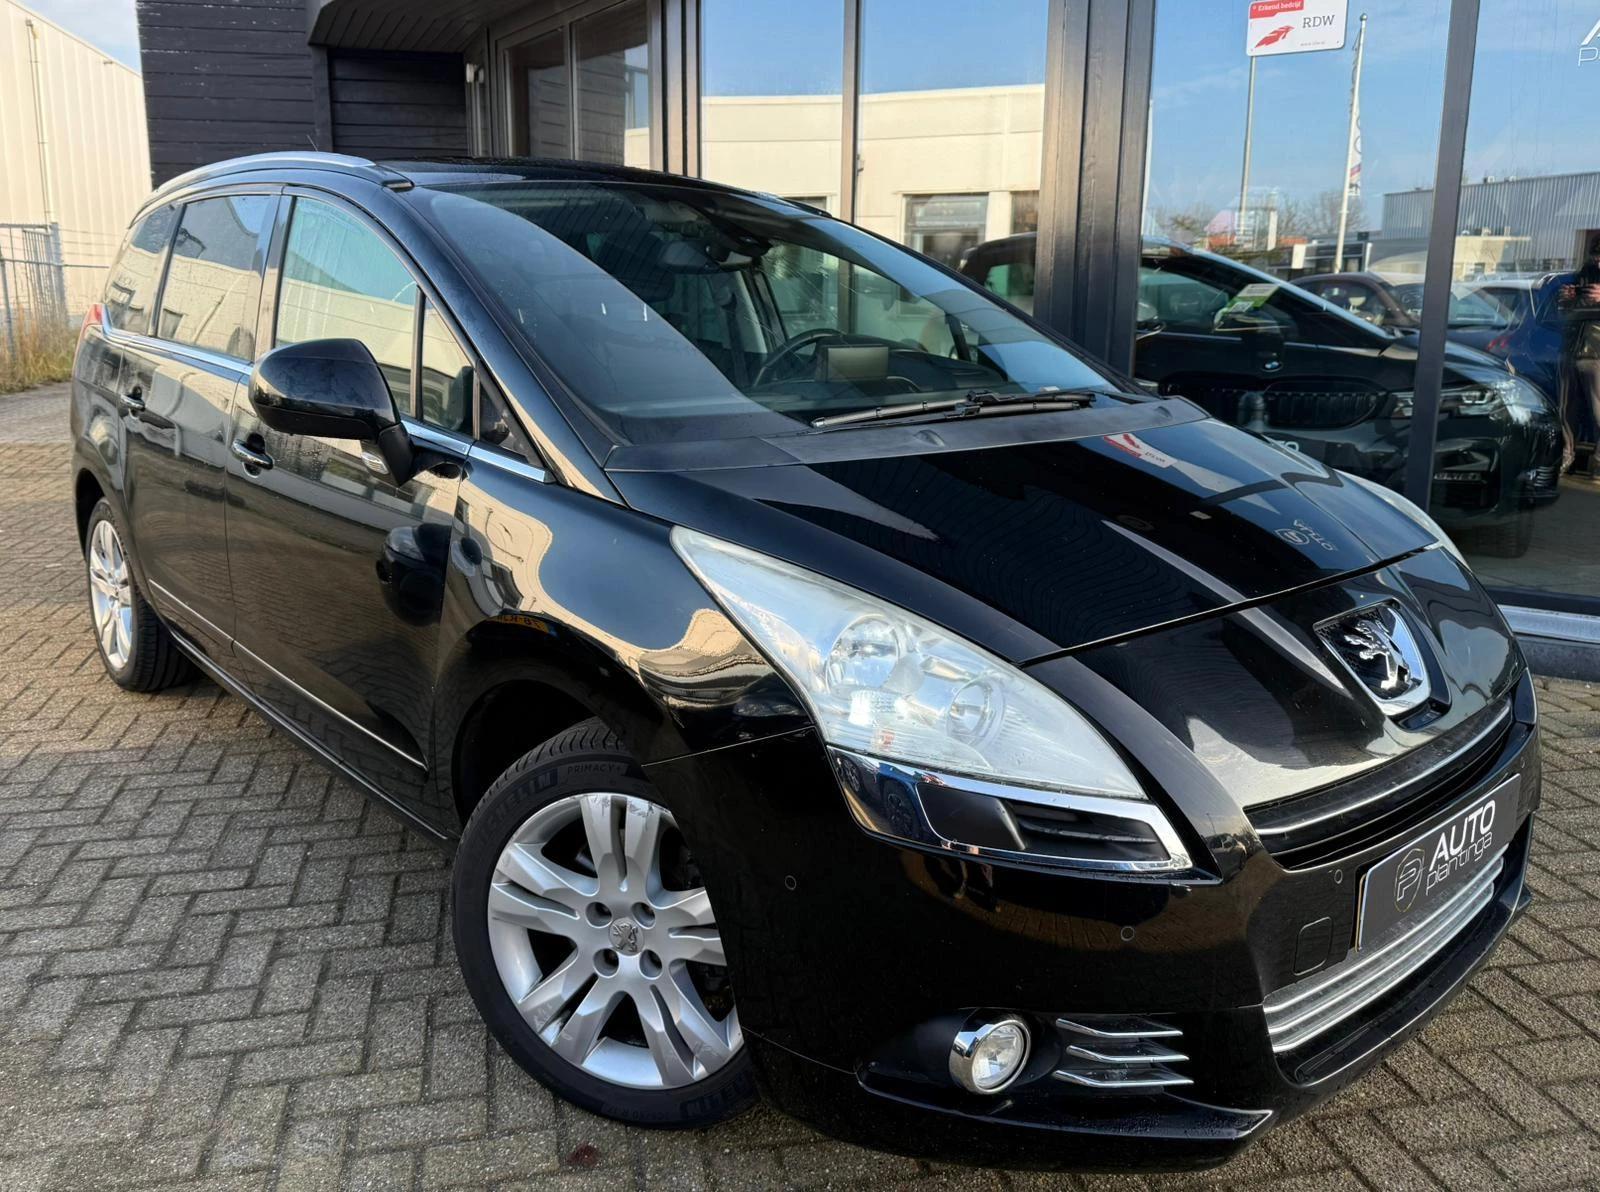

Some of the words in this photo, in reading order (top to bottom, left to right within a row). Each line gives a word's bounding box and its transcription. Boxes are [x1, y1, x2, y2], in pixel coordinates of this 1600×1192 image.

[1302, 14, 1335, 29] RDW
[567, 764, 614, 775] PRIMACY
[1429, 800, 1496, 872] AUTO
[1426, 831, 1493, 896] plantinga
